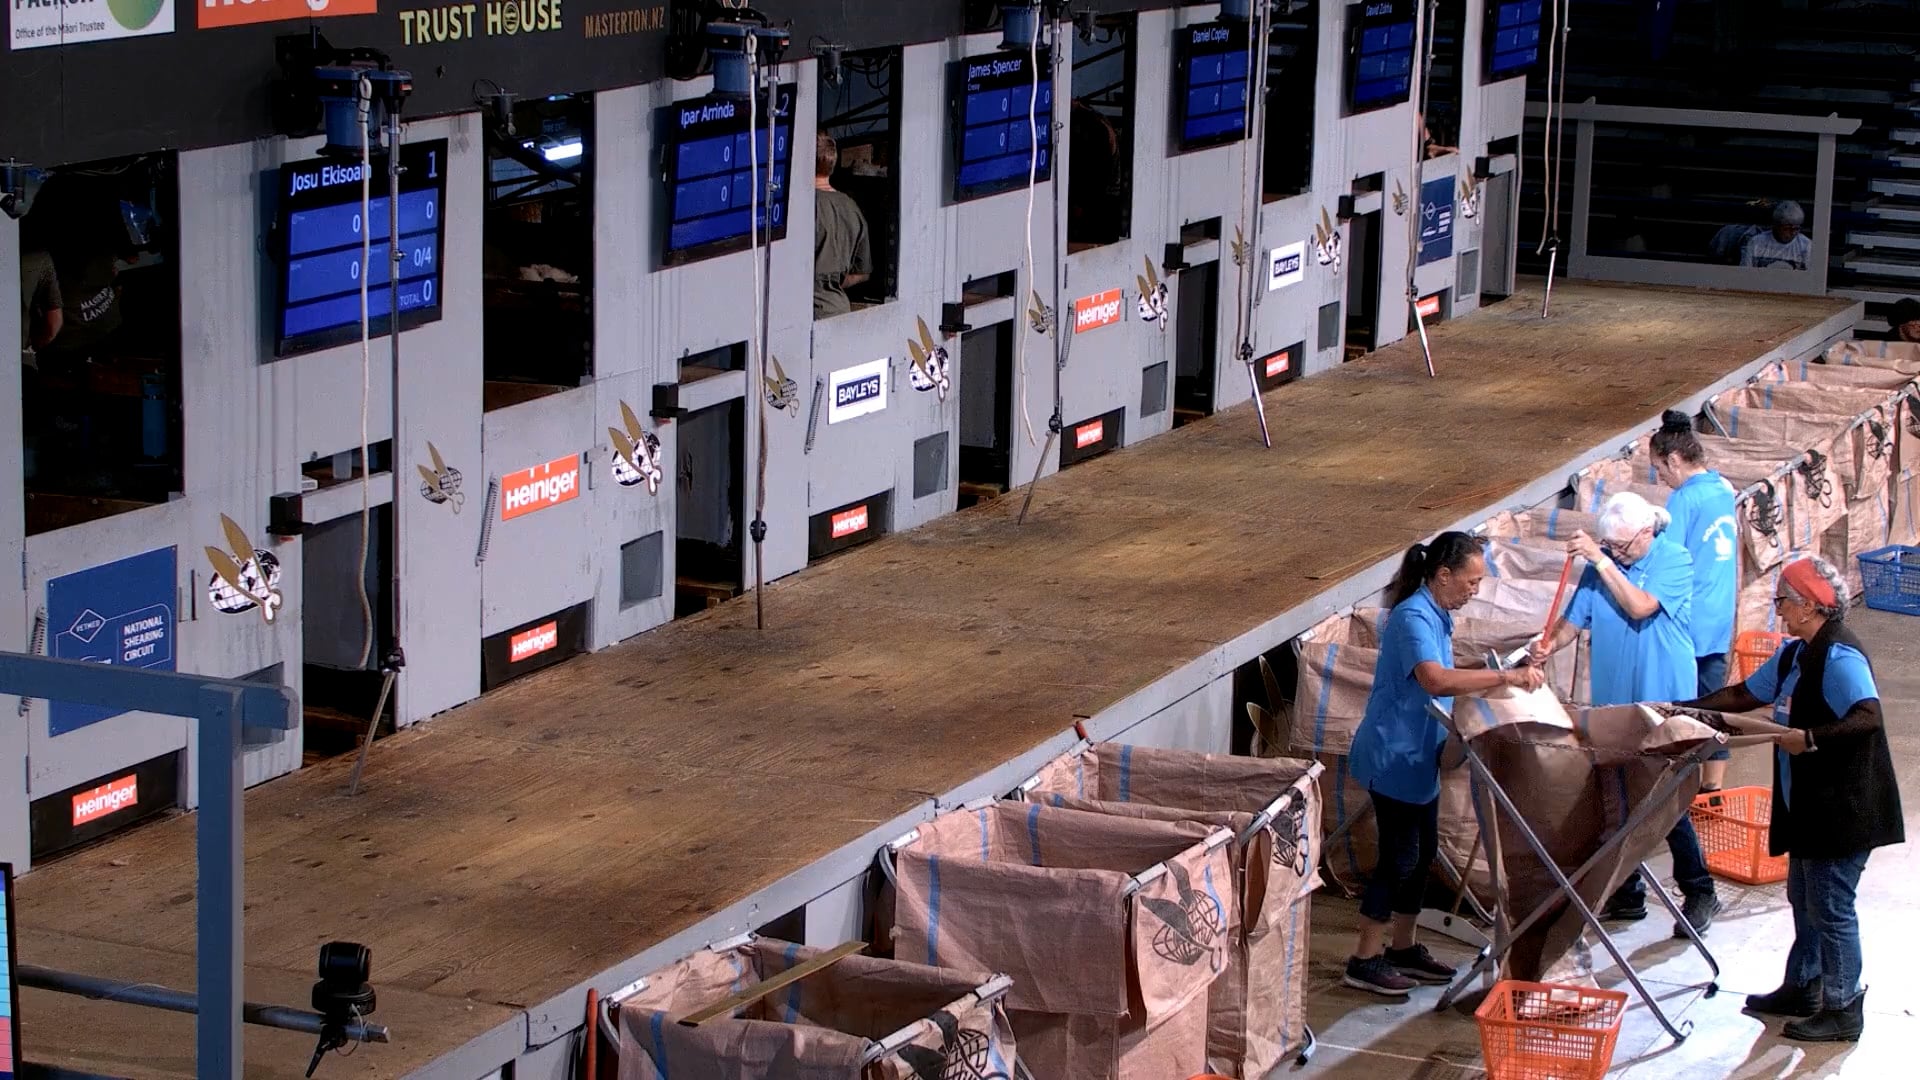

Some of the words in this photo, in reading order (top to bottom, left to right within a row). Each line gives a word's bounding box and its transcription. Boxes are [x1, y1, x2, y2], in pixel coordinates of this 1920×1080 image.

[15, 28, 35, 40] Office
[36, 25, 44, 37] of
[45, 25, 56, 36] the
[79, 21, 105, 33] Trustee
[400, 5, 476, 45] TRUST
[486, 0, 562, 36] HOUSE
[584, 6, 666, 39] MASTERTON.NZ
[1193, 28, 1211, 43] Daniel
[1211, 26, 1230, 43] Copley
[968, 64, 991, 82] James
[992, 59, 1022, 78] Spencer
[781, 93, 789, 117] 2
[681, 107, 699, 129] Ipar
[724, 146, 730, 162] 0
[778, 136, 784, 152] 0
[428, 151, 438, 178] 1
[290, 171, 318, 196] Josu
[721, 185, 727, 201] 0
[426, 201, 434, 219] 0
[772, 203, 780, 222] 0
[352, 214, 361, 233] 0
[414, 247, 432, 268] 0/4
[351, 261, 359, 280] 0
[400, 294, 421, 306] TOTAL
[423, 280, 432, 301] 0
[1077, 294, 1120, 327] Heiniger
[839, 379, 879, 403] BAYLEYS
[506, 465, 578, 511] Heiniger
[124, 616, 164, 636] NATIONAL
[124, 628, 164, 649] SHEARING
[512, 628, 557, 656] Heiniger
[124, 644, 155, 661] CIRCUIT
[75, 783, 136, 818] Heiniger
